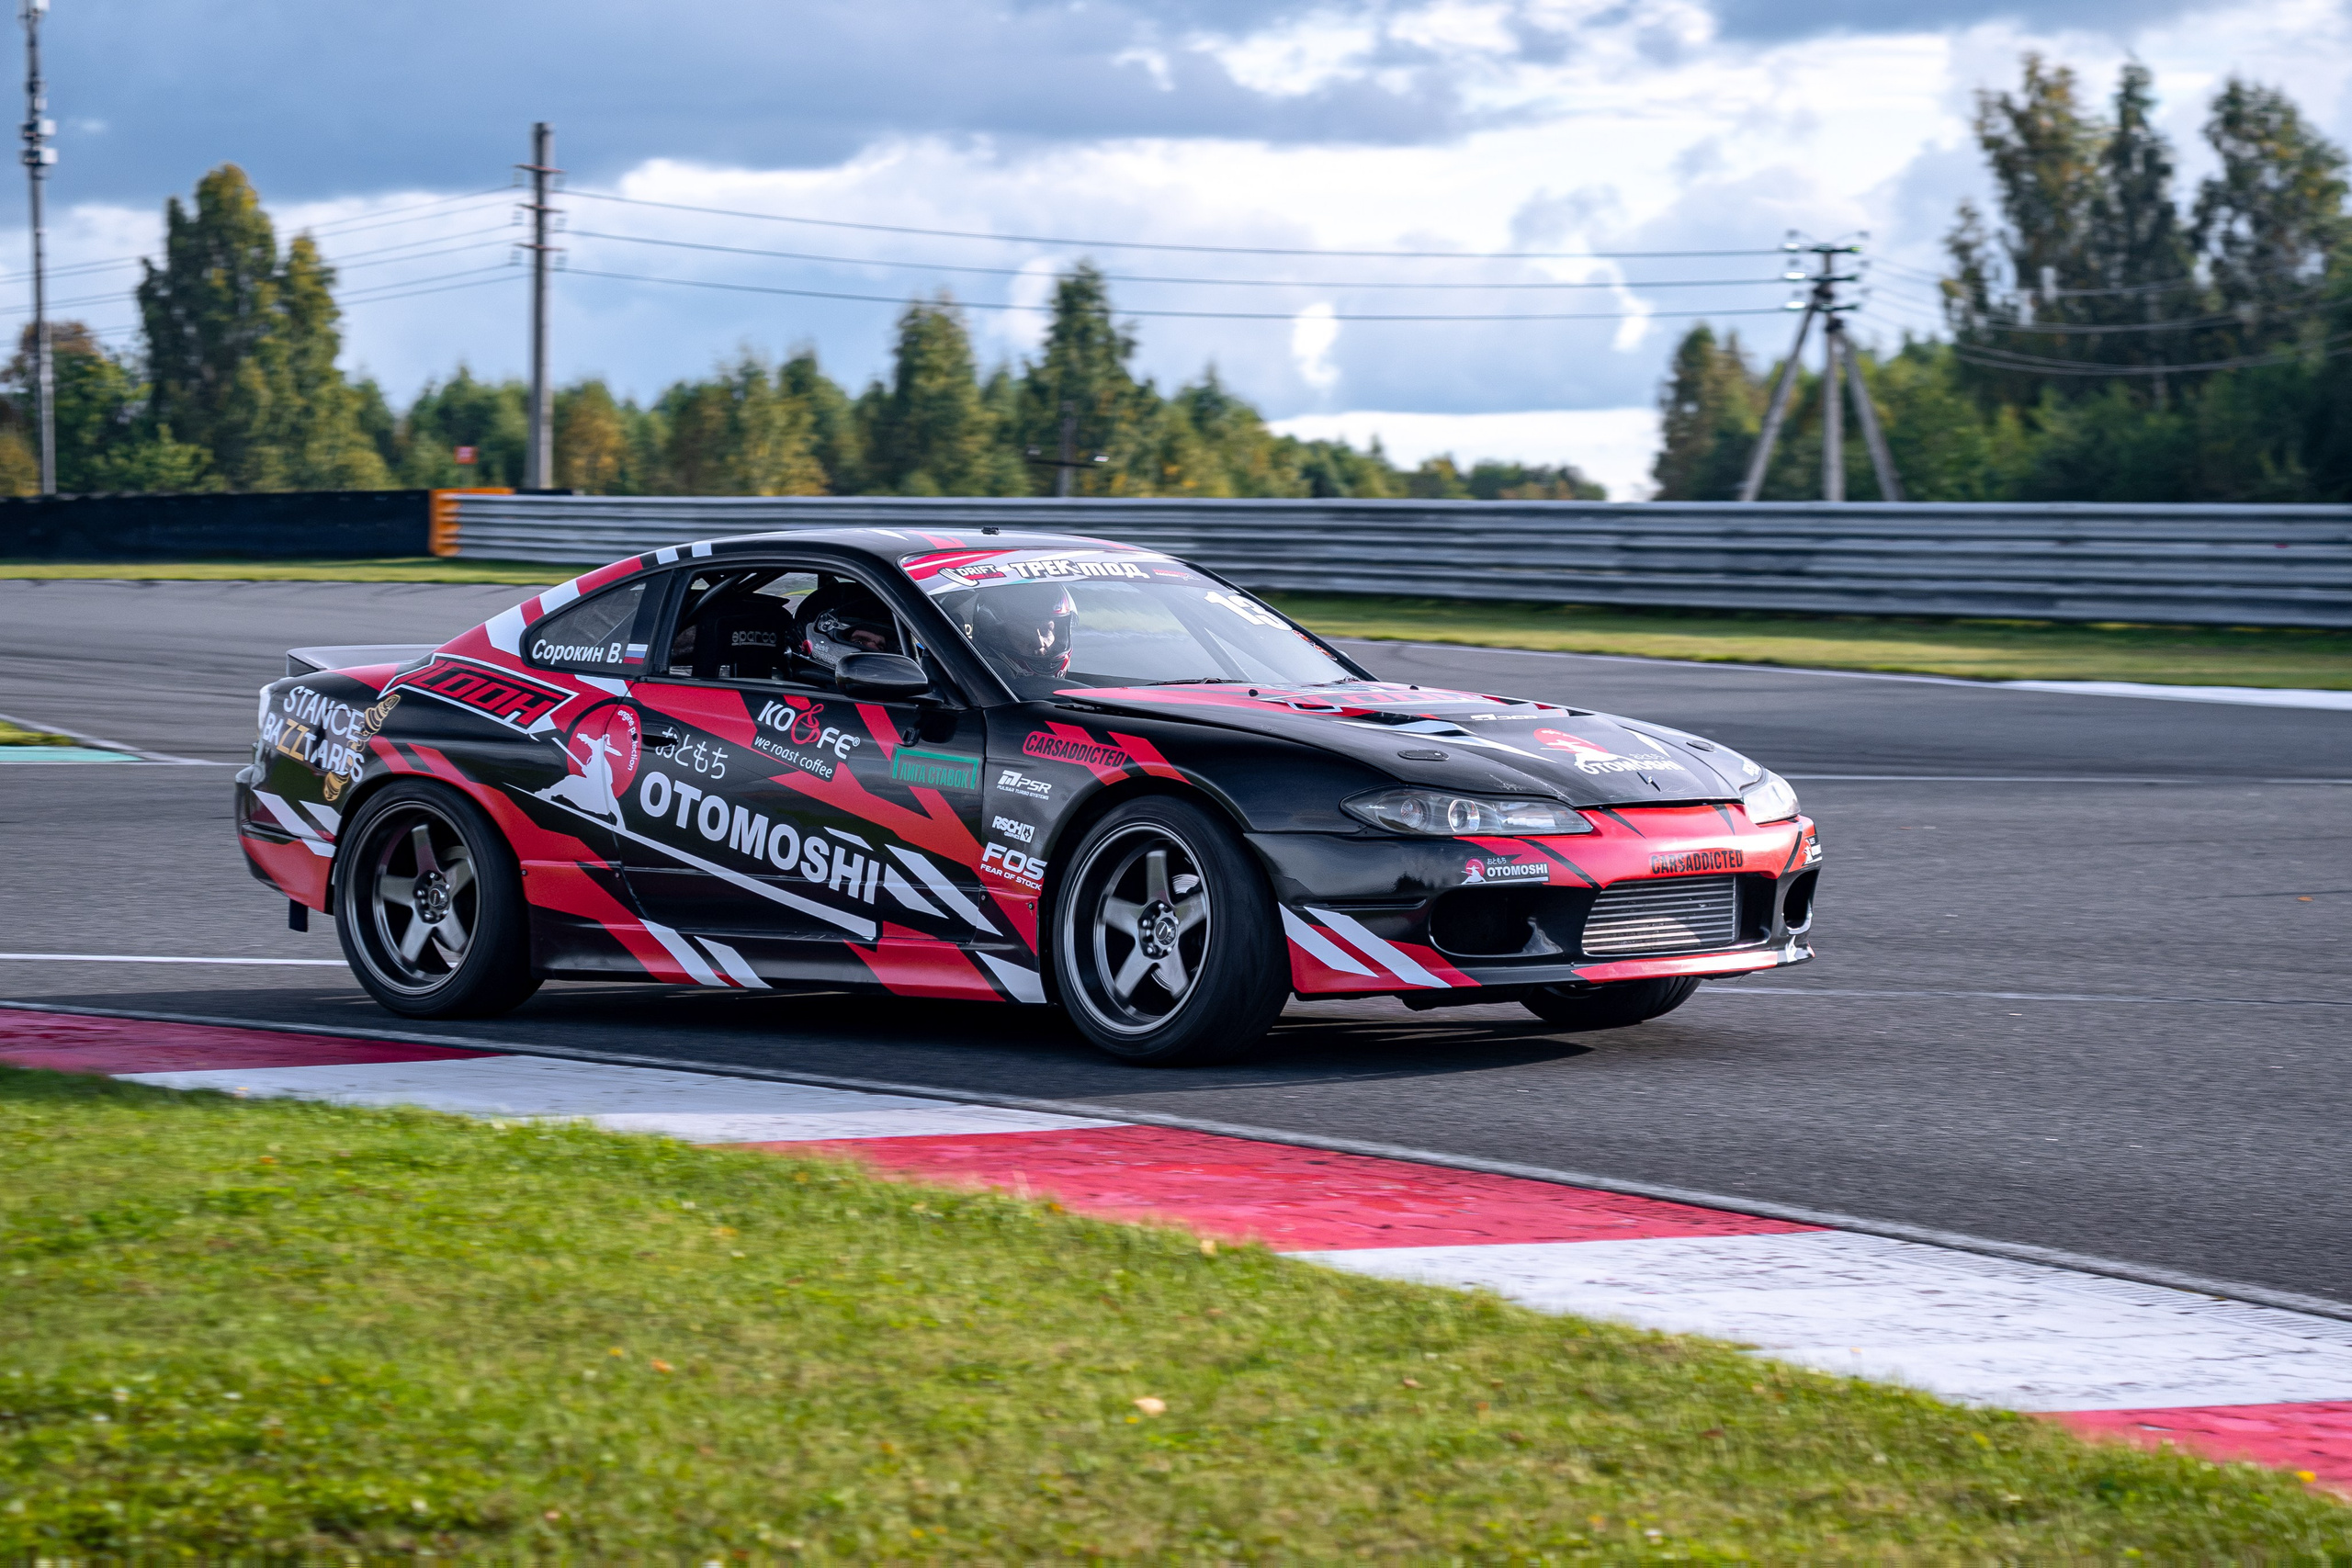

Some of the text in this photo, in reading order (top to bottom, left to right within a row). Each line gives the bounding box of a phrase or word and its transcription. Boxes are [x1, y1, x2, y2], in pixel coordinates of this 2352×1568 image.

[956, 564, 997, 577] DRIFT
[1204, 591, 1293, 630] 13
[532, 639, 605, 665] Сорокин
[283, 685, 365, 742] STANCE
[263, 712, 365, 783] BAZZTARDS
[617, 710, 639, 771] engine ptection
[1025, 734, 1126, 768] CARSADDICTED
[754, 736, 833, 779] we roast coffee
[899, 762, 970, 789] ЛИГА СТАВОК
[1016, 777, 1052, 794] PSR
[640, 771, 880, 905] OTOMOSHI
[992, 815, 1023, 835] RSCH
[982, 841, 1047, 881] FOS
[1487, 863, 1548, 877] OTOMOSHI
[1650, 850, 1744, 874] CARSADDICTED
[980, 863, 1043, 891] FEAR OF STOCK
